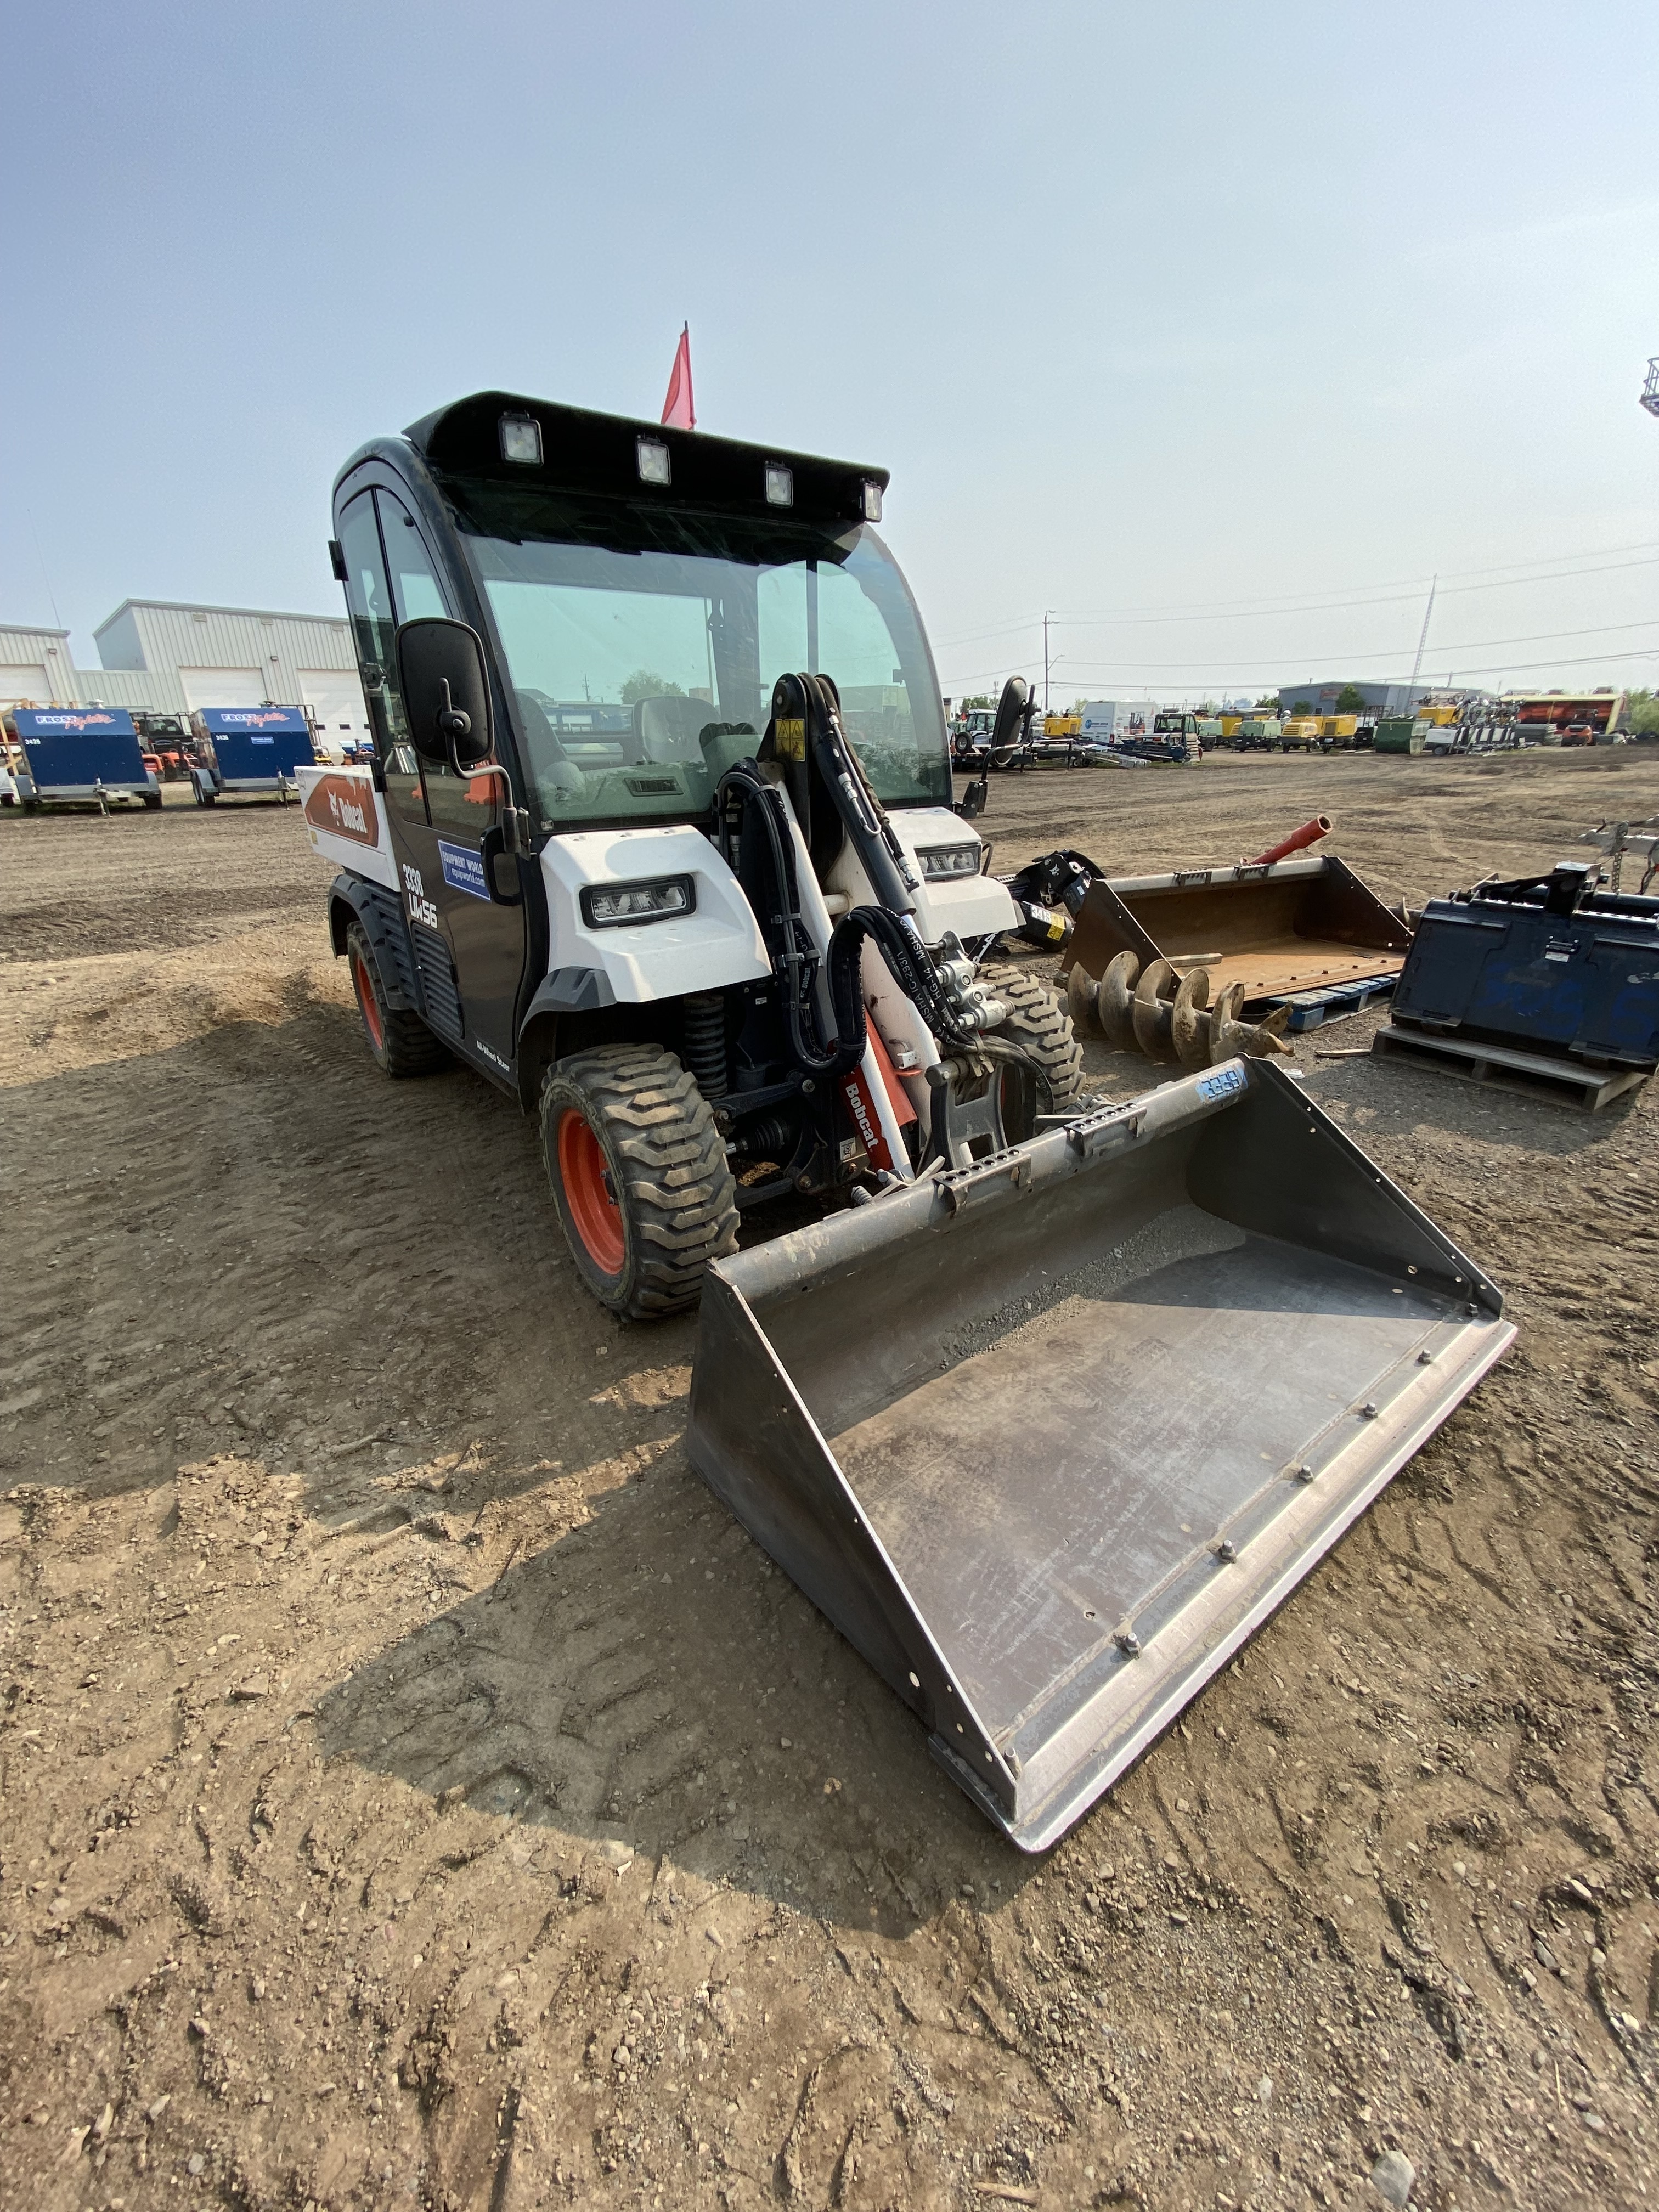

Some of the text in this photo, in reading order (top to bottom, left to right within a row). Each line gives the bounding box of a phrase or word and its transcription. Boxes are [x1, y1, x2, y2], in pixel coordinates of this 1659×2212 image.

[338, 797, 368, 833] Bobcat
[403, 863, 424, 898] 3338
[442, 851, 484, 876] EQUIPMENT WORLD
[452, 867, 486, 888] equipworld.com
[409, 893, 438, 929] UW56
[897, 951, 918, 993] IC-293/1
[923, 967, 942, 1001] HG-14
[915, 994, 935, 1024] MSHA
[845, 1082, 879, 1148] Bobcat
